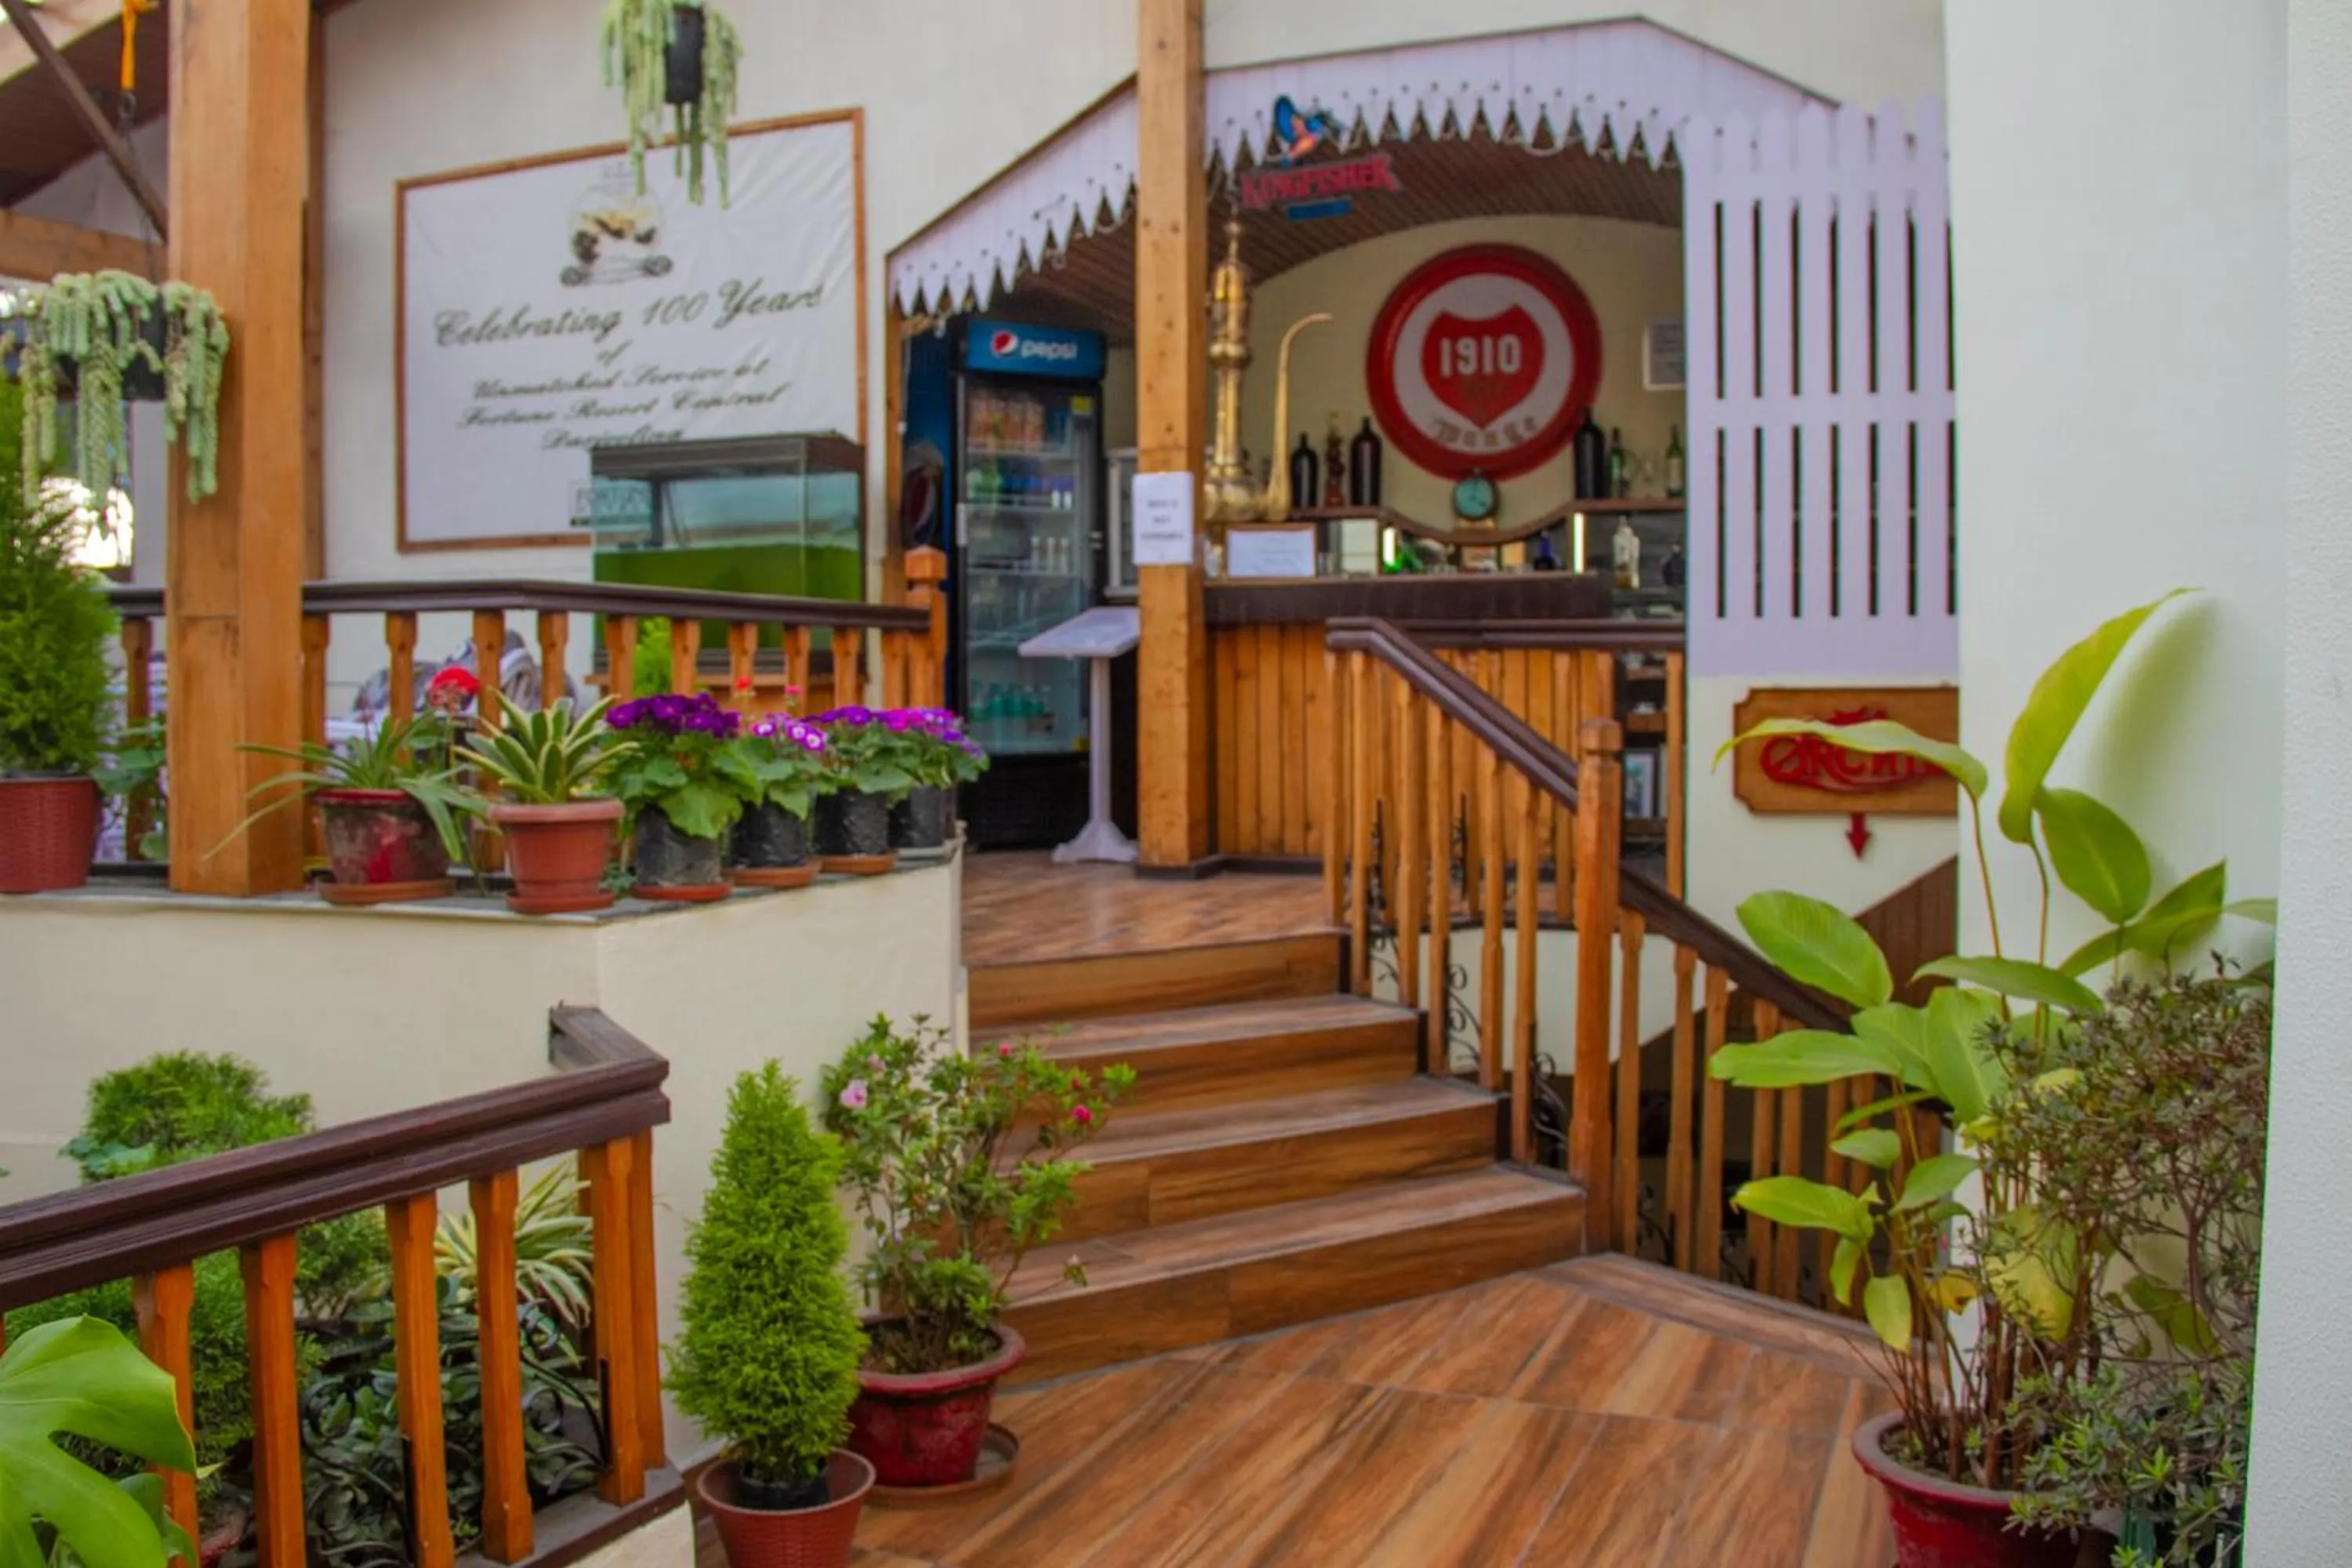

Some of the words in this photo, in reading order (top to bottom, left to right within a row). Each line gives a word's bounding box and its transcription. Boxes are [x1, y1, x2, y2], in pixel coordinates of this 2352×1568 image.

[433, 303, 622, 347] Celebrating
[642, 291, 708, 326] 100
[713, 277, 824, 329] Years
[594, 339, 632, 366] of
[1021, 339, 1078, 361] pepsi
[1439, 332, 1523, 378] 1910
